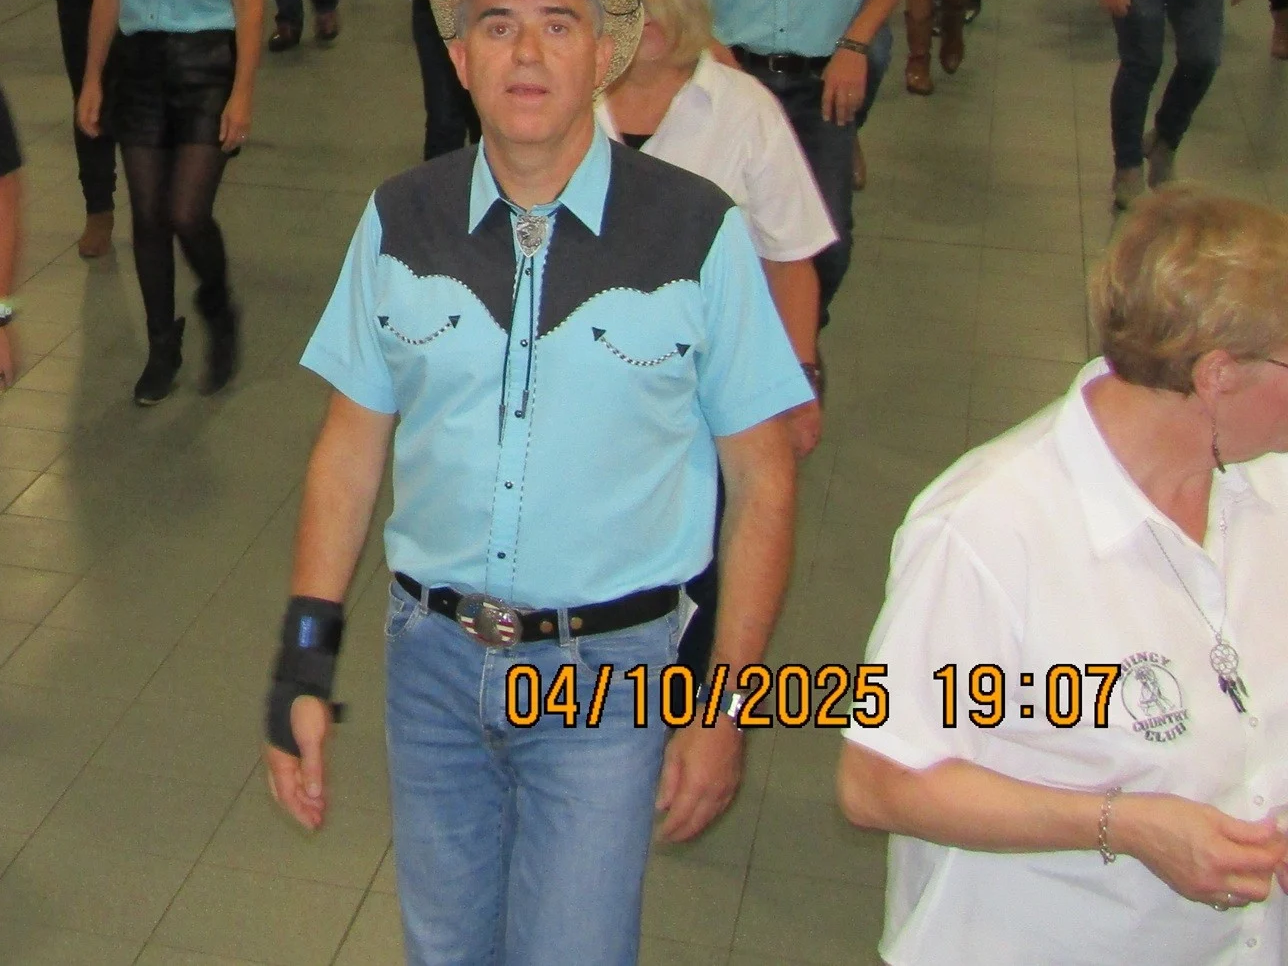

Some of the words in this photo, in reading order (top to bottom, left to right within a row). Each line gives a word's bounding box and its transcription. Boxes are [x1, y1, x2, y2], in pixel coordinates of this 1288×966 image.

[1119, 651, 1171, 679] UINCY
[1132, 708, 1190, 733] COUNTRY
[1144, 722, 1187, 743] CLUB
